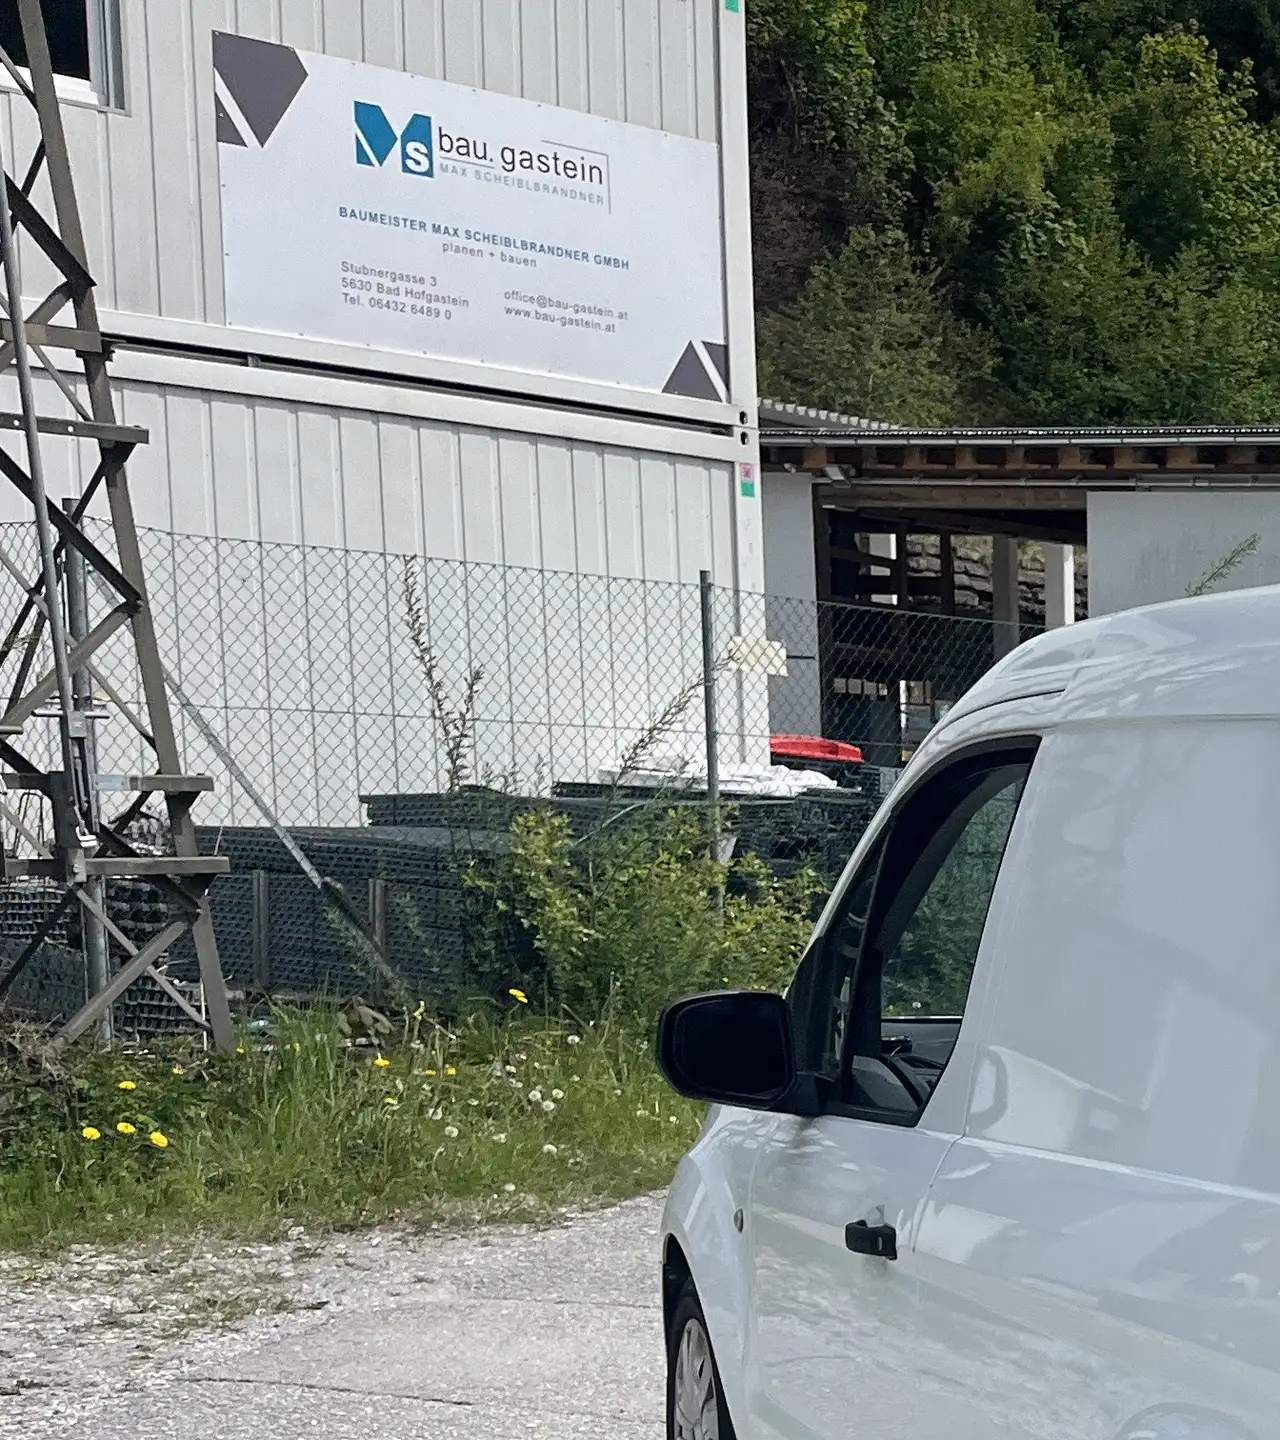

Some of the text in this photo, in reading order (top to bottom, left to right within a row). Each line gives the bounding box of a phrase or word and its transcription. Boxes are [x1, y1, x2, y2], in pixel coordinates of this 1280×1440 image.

[500, 146, 603, 185] gastein
[440, 163, 604, 205] MAX SCHEIBLBRANDNER
[339, 206, 630, 271] BAUMEISTER MAX SCHEIBLBRANDNER GMBH
[442, 242, 484, 258] planen
[500, 251, 538, 267] bauen
[341, 260, 437, 287] Stubnergasse 3
[341, 277, 470, 308] 5630 Bad Hofgastein
[342, 292, 452, 320] Tel. 06432 6489 0
[503, 290, 628, 321] office@bau-gastein.at
[504, 305, 616, 333] www.bau-gastein.at
